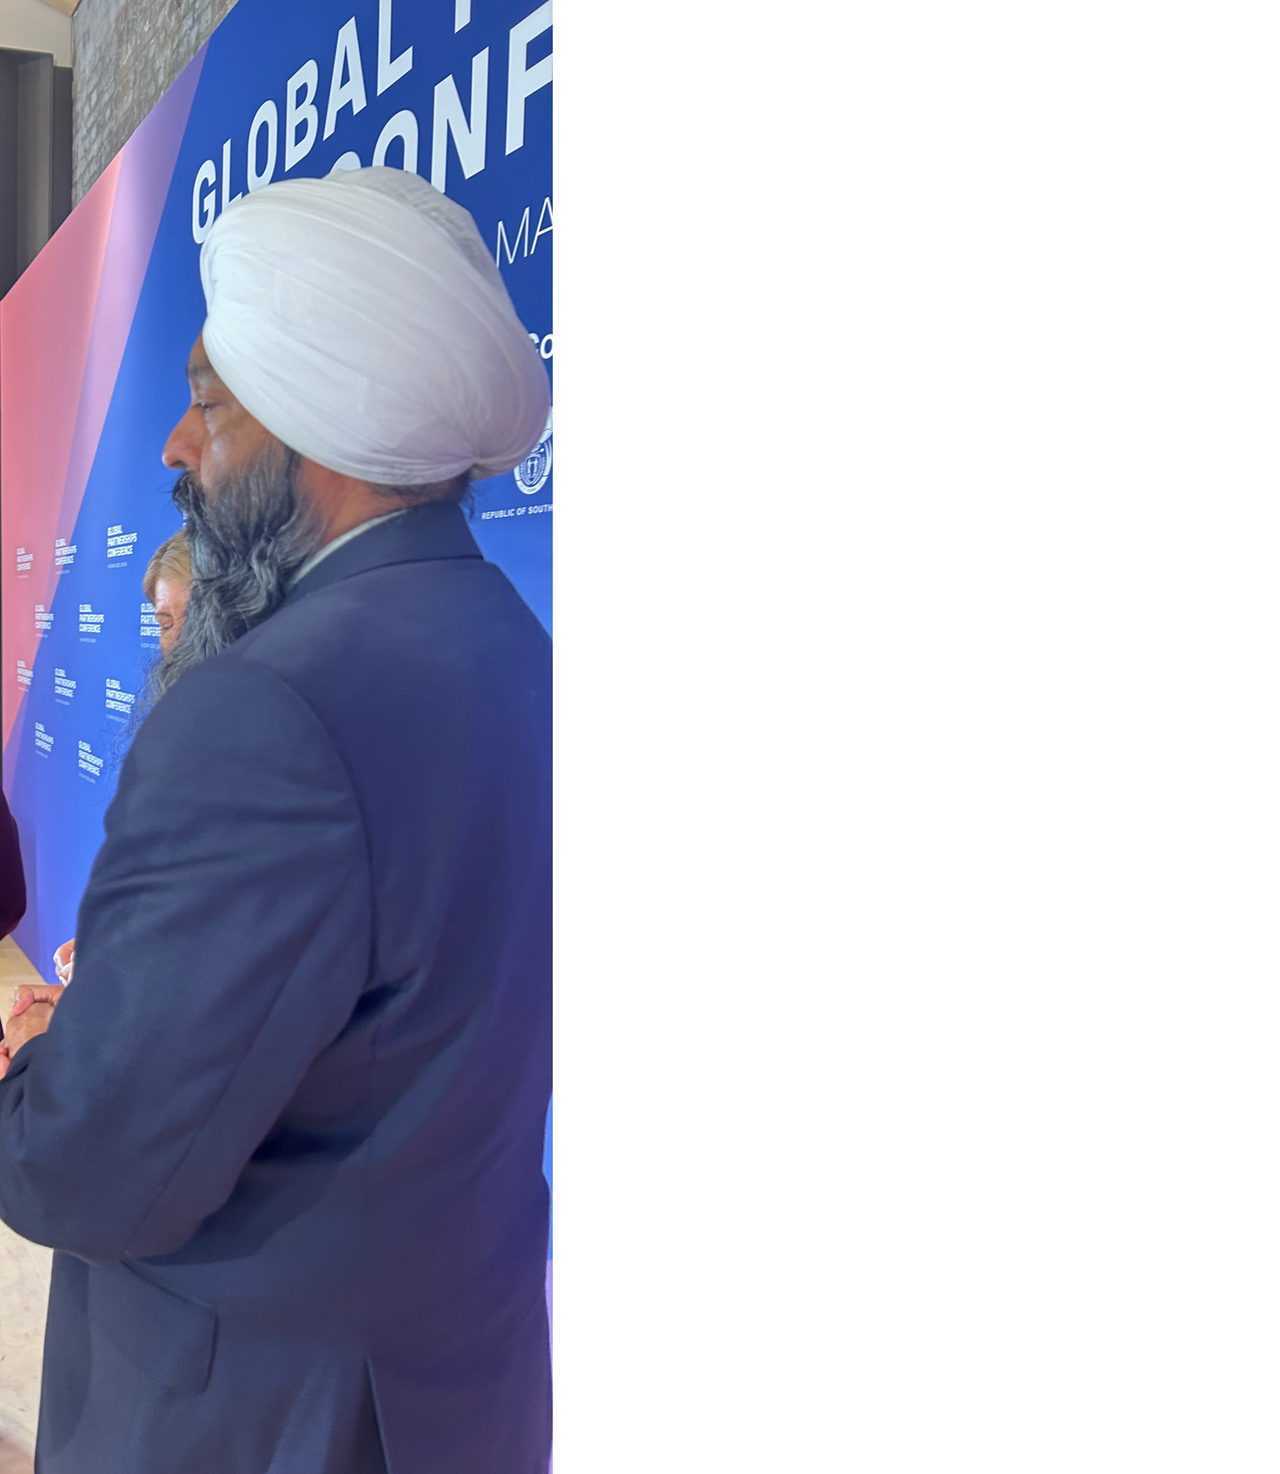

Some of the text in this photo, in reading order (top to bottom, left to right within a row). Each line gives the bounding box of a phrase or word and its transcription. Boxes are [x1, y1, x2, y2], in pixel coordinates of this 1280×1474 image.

[192, 0, 413, 244] GLOBAL
[481, 508, 515, 520] REPUBLIC
[516, 507, 527, 516] OF
